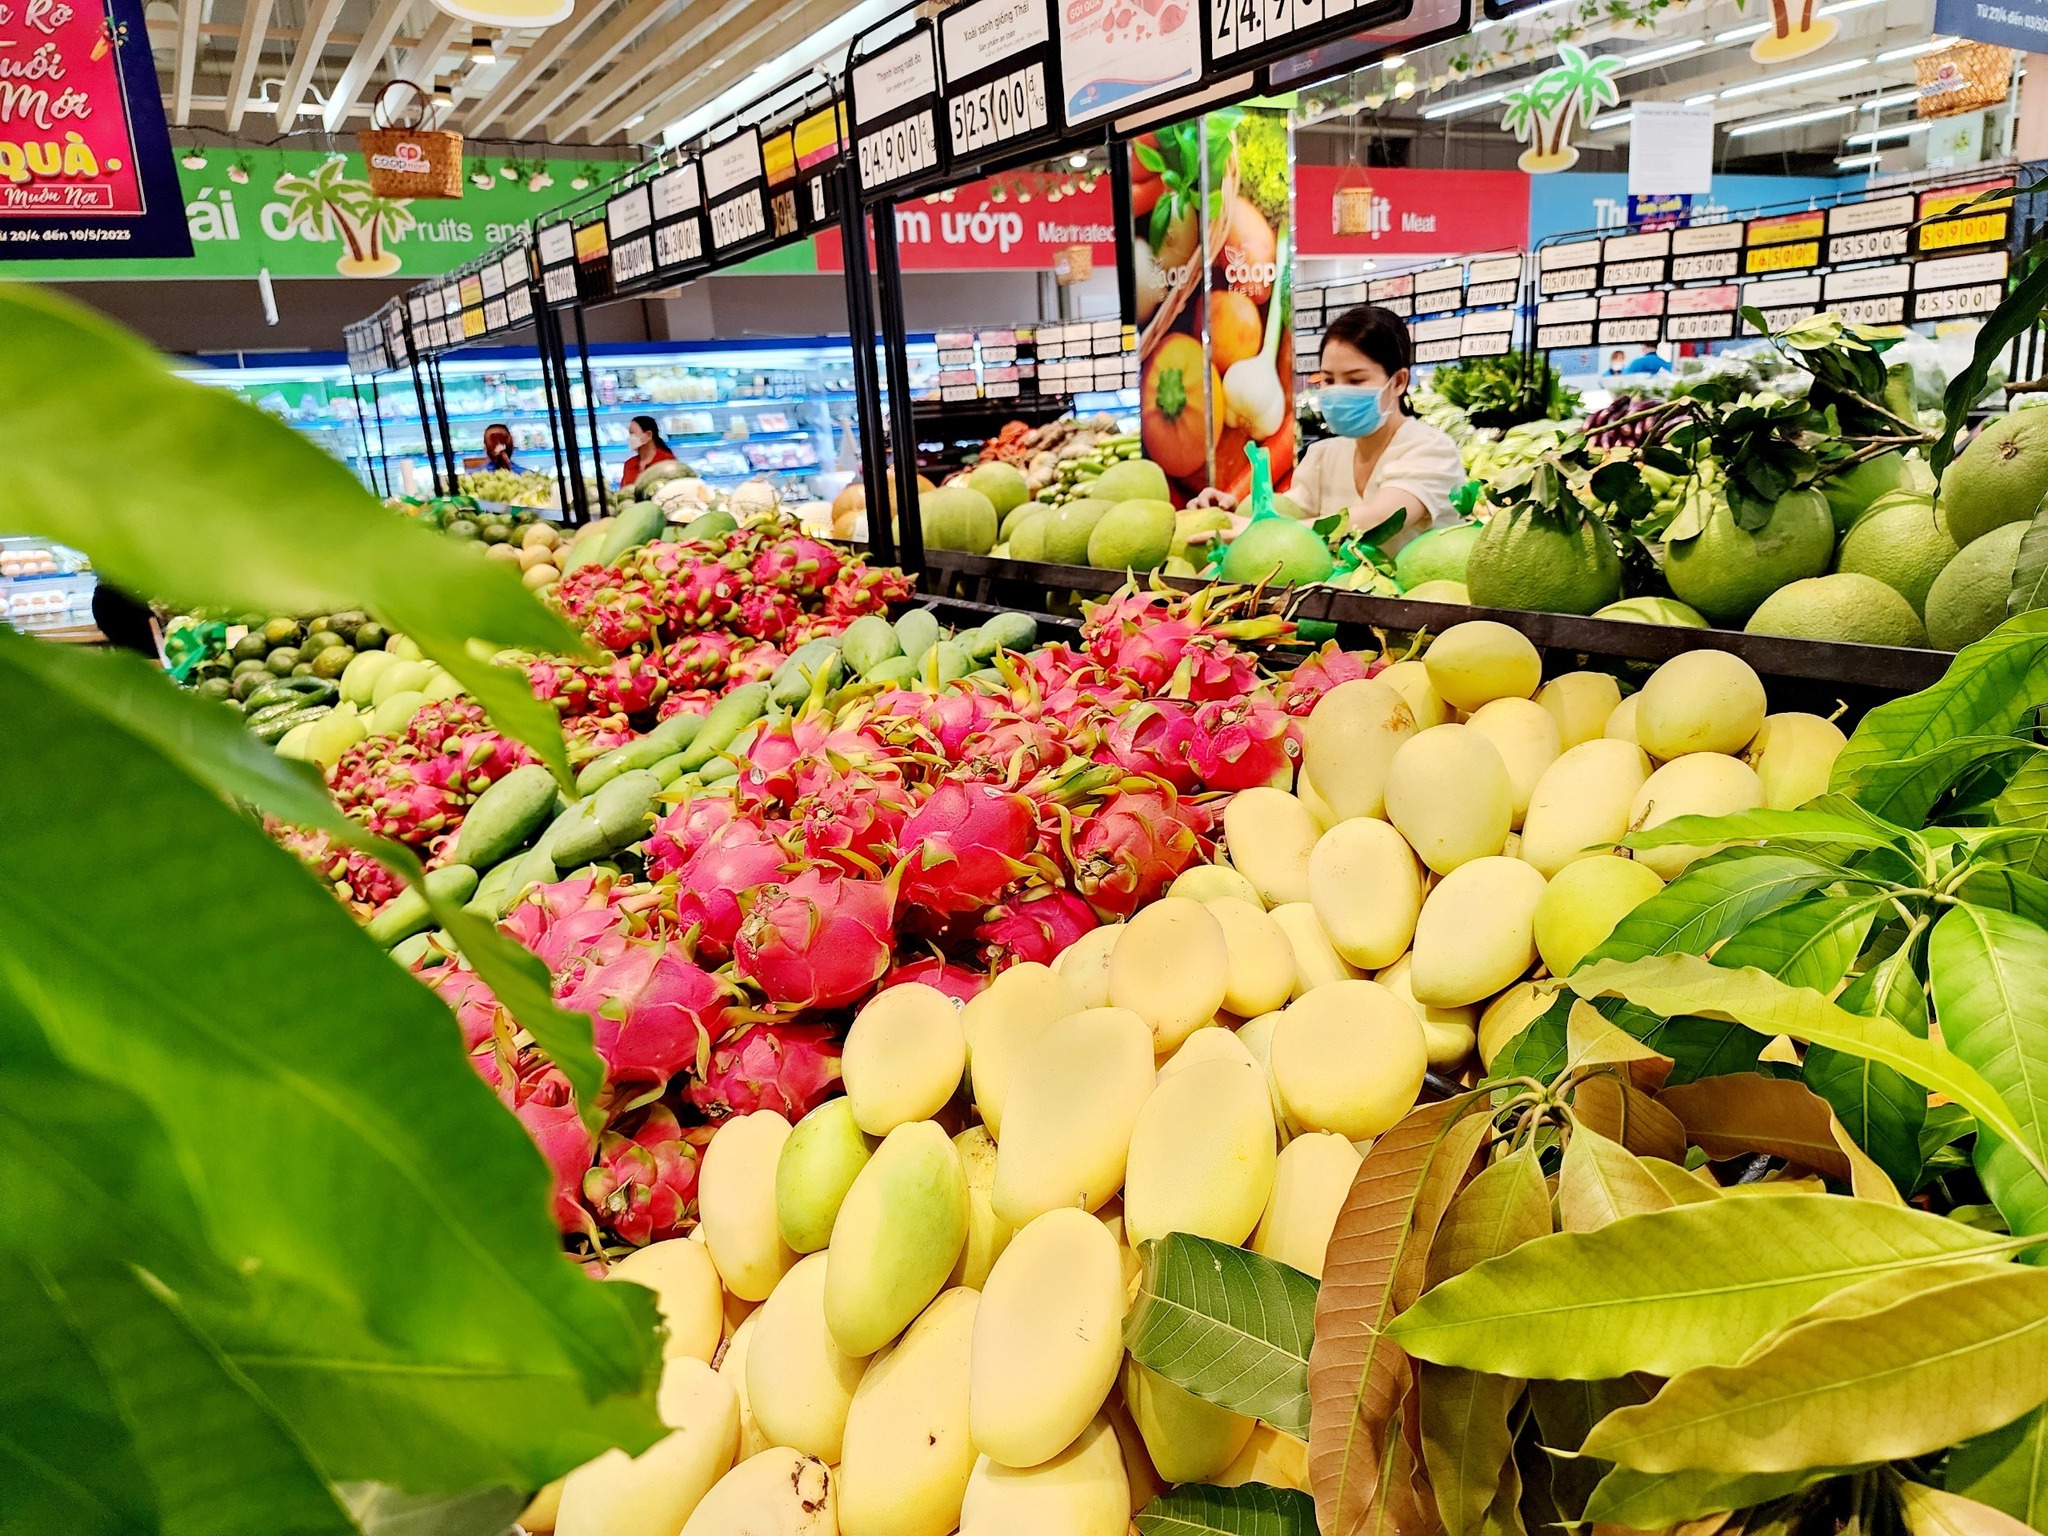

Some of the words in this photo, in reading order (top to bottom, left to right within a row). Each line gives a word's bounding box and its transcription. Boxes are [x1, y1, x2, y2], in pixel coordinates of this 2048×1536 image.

[0, 41, 66, 80] uổi
[0, 81, 92, 130] Mới
[0, 131, 99, 183] QUÀ
[861, 124, 917, 178] 24.900
[4, 187, 61, 209] Muôn
[64, 186, 99, 209] Nơi
[185, 187, 241, 242] ái
[1401, 211, 1437, 233] Meat
[9, 229, 40, 242] 20/4
[42, 229, 69, 241] đến
[69, 228, 131, 242] 10/5/2023
[941, 201, 1023, 253] ướp
